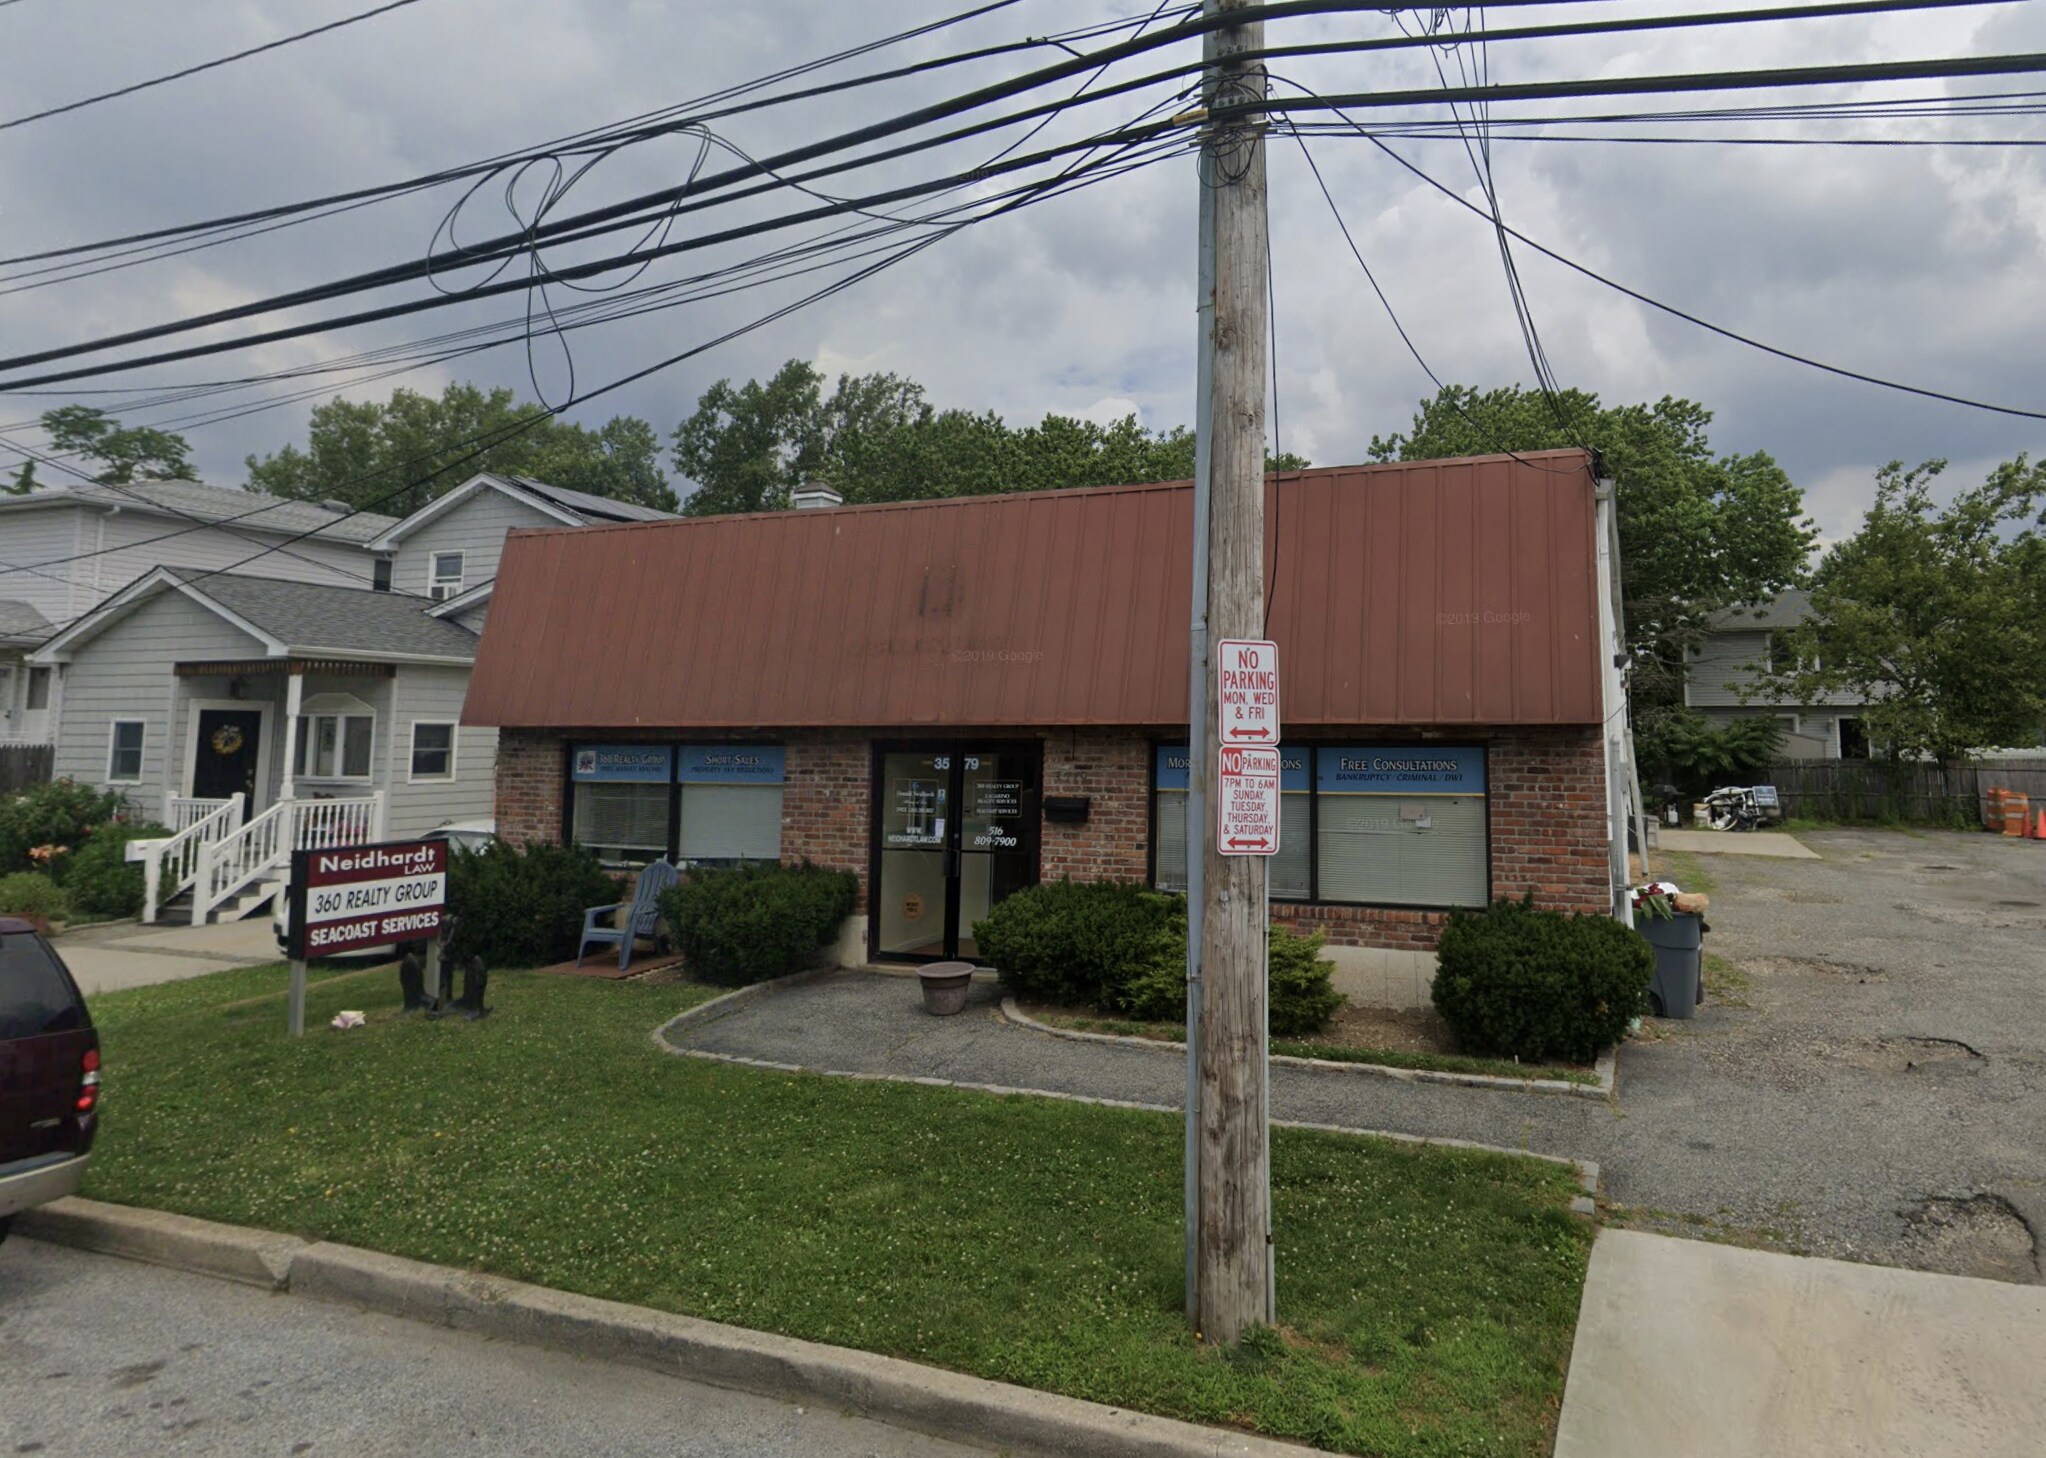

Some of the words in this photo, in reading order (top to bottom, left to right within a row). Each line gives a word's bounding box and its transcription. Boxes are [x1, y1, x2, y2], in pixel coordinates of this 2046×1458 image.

[1238, 650, 1259, 669] NO
[1223, 671, 1275, 691] PARKING
[1224, 692, 1248, 705] MON,
[1253, 692, 1275, 705] WED
[1235, 706, 1244, 719] &
[1248, 707, 1265, 720] FRI
[641, 754, 665, 765] GROUP
[705, 755, 732, 765] SHORT
[734, 754, 760, 766] SALES
[934, 758, 950, 769] 35
[964, 758, 980, 770] 79
[1222, 753, 1241, 773] NO
[1242, 756, 1276, 772] PARKING
[1340, 757, 1368, 771] FREE
[1373, 757, 1458, 771] CONSULTATIONS
[1224, 778, 1241, 788] 7PM
[1245, 778, 1255, 789] TO
[1258, 779, 1275, 789] 6AM
[1335, 773, 1390, 782] BANKRUPTCY
[1396, 774, 1437, 782] CRIMINAL
[988, 826, 1004, 835] 516
[1223, 824, 1230, 834] &
[1234, 824, 1273, 835] SATURDAY
[974, 836, 1017, 846] 809-7900
[319, 845, 436, 873] Neidhardt
[404, 862, 436, 875] LAW
[314, 893, 342, 914] 360
[345, 886, 392, 910] REALTY
[395, 880, 438, 902] GROUP
[310, 920, 378, 946] SEACOAST
[381, 911, 440, 935] SERVICES
